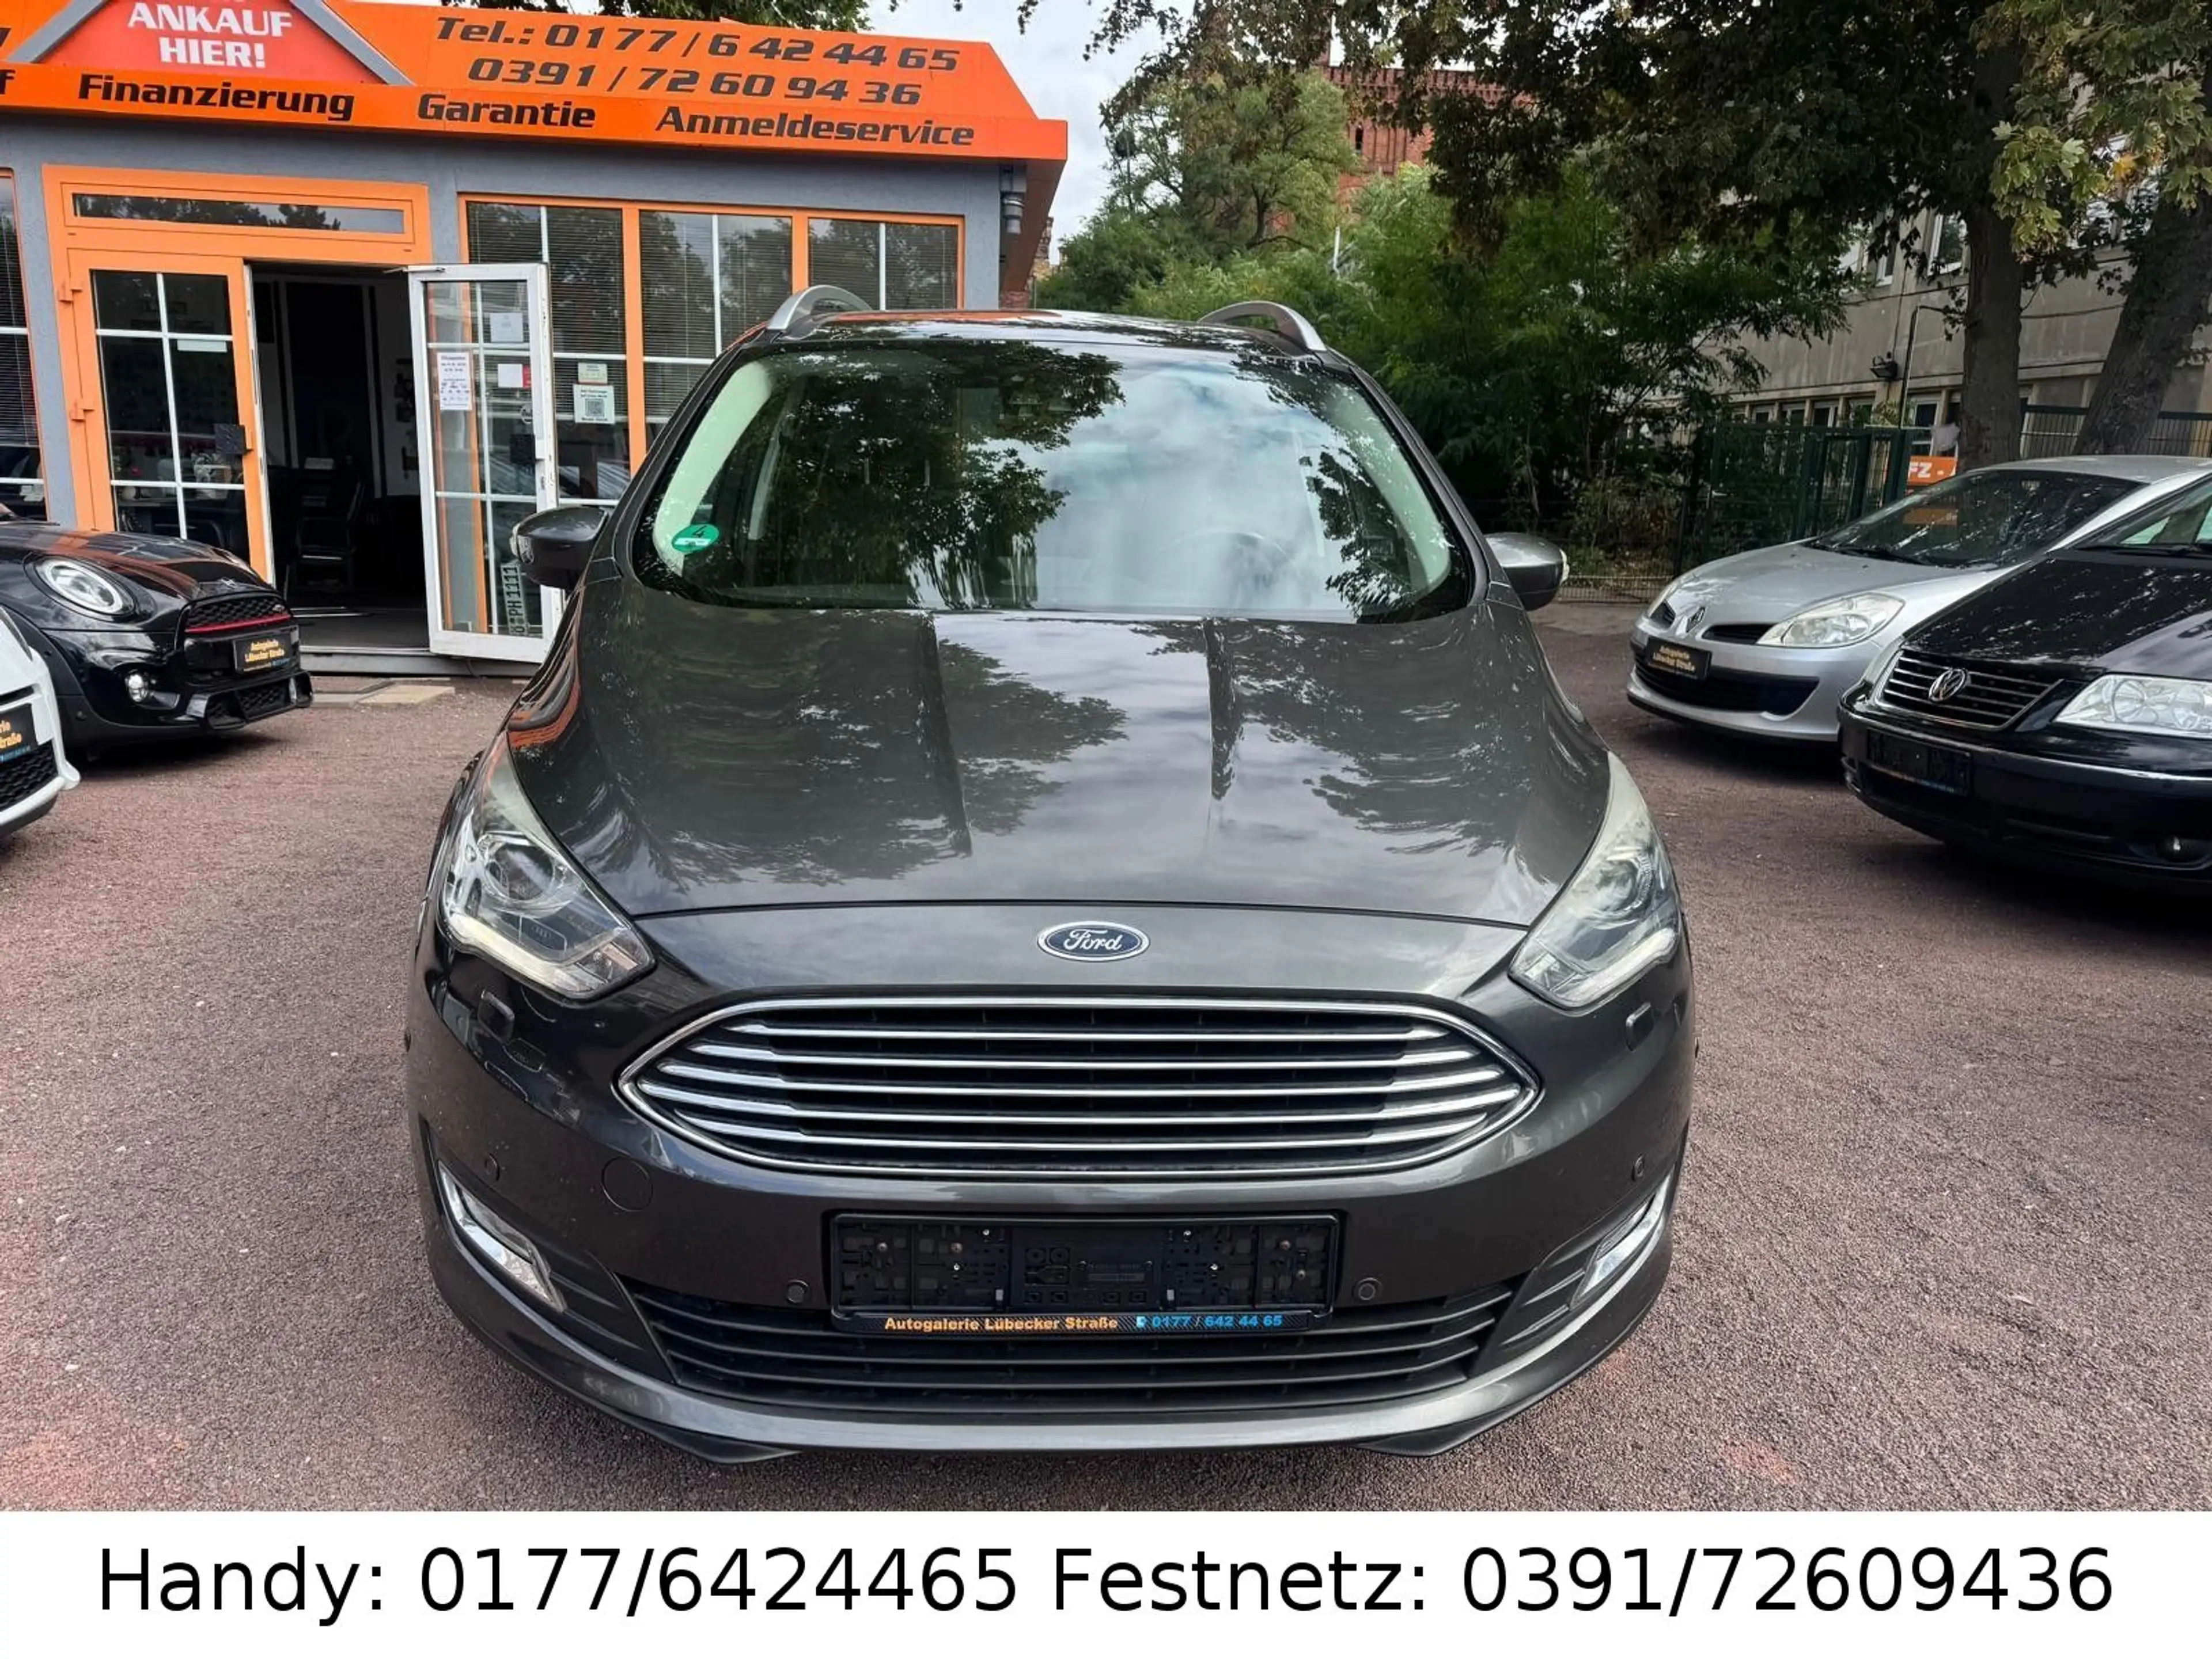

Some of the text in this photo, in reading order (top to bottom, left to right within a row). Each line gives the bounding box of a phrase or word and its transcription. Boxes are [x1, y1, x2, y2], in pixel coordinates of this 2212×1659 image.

[129, 2, 291, 37] ANKAUF
[160, 37, 265, 68] HIER!
[437, 17, 535, 45] Tel.:
[545, 24, 677, 52] 0177
[708, 34, 740, 56] 6
[749, 37, 814, 62] 42
[824, 43, 887, 66] 44
[897, 48, 960, 71] 65
[468, 58, 596, 88] 0391
[637, 67, 699, 93] 72
[710, 73, 775, 97] 60
[784, 77, 848, 101] 94
[858, 82, 922, 105] 36
[79, 74, 355, 122] Finanzierung
[418, 94, 596, 128] Garantie
[656, 106, 974, 145] Anmeldeservice
[1063, 929, 1124, 950] Ford
[885, 1317, 979, 1332] Autogalerie
[984, 1317, 1060, 1331] Lübecker
[1065, 1316, 1118, 1330] Straße
[1152, 1316, 1192, 1328] 0177
[1204, 1316, 1234, 1328] 642
[1238, 1316, 1259, 1327] 44
[1263, 1315, 1283, 1327] 65
